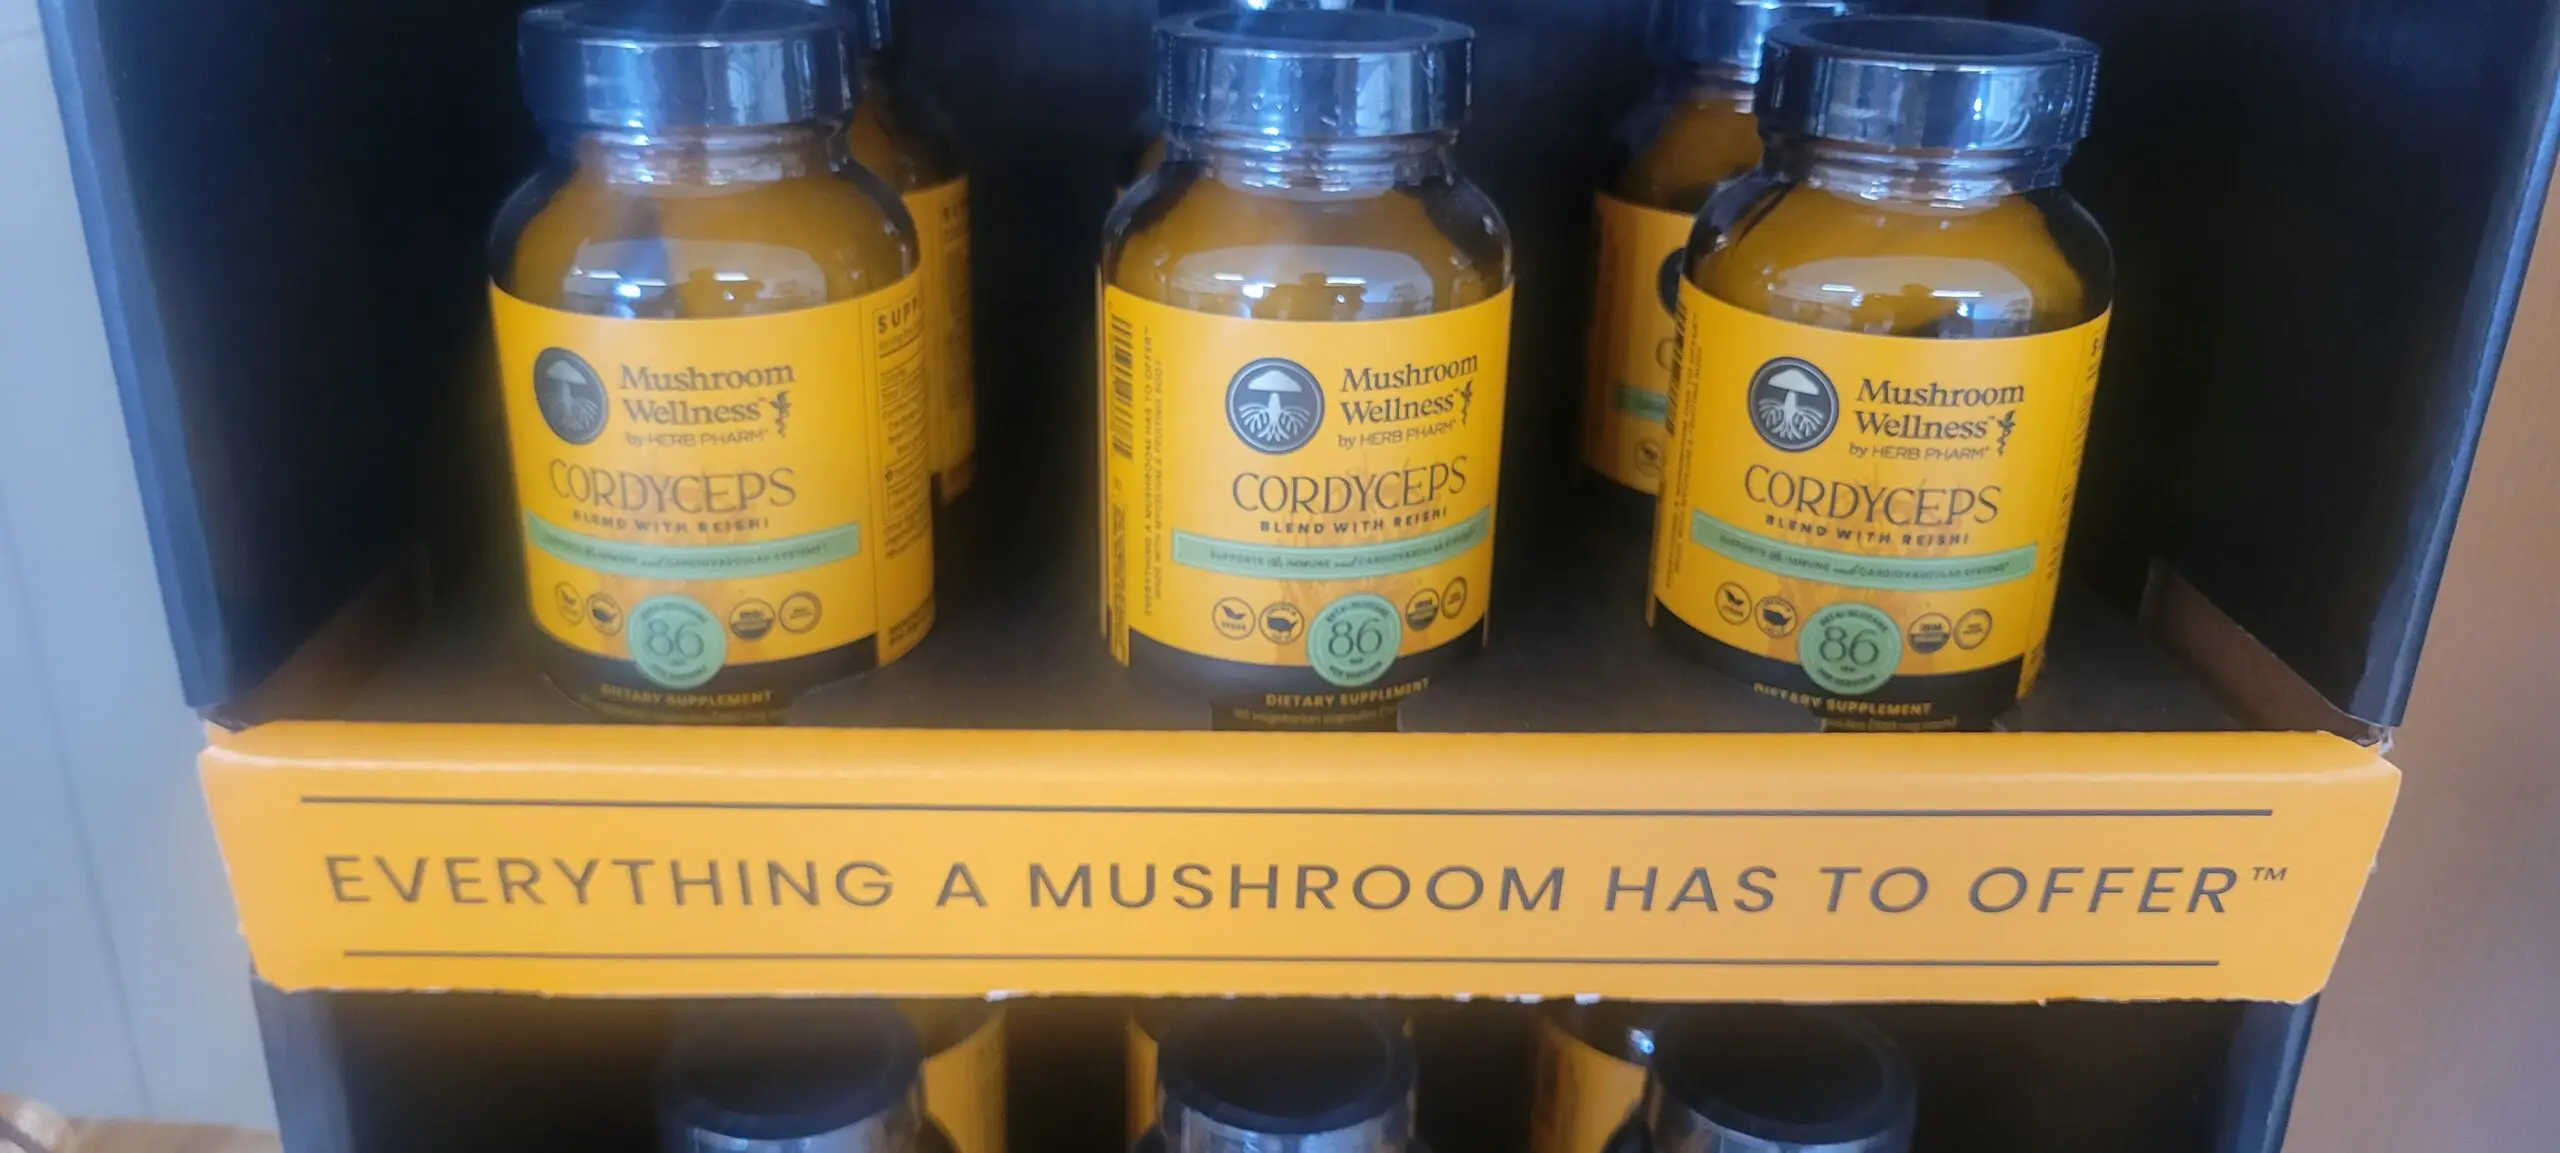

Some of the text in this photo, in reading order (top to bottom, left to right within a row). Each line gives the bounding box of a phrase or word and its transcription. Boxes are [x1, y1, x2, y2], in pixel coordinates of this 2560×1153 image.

[618, 364, 797, 391] Mushroom
[1340, 354, 1478, 392] Mushroom
[1856, 377, 2025, 407] Mushroom
[626, 432, 643, 447] by
[648, 432, 696, 447] HERB
[1338, 434, 1356, 449] by
[1360, 430, 1403, 446] HERB
[1849, 443, 1868, 458] by
[1872, 445, 1920, 461] HERB
[550, 458, 796, 514] CORDYCEPS
[1232, 456, 1467, 515] CORDYCEPS
[1744, 464, 2002, 527] CORDYCEPS
[573, 510, 770, 533] BLEND WITH REISHI
[1260, 507, 1447, 534] BLEND WITH REISHI
[1766, 514, 1969, 545] BLEND WITH REISHI
[647, 618, 705, 660] 86
[1328, 617, 1383, 658] 86
[1819, 625, 1880, 667] 86
[665, 690, 774, 706] SUPPLEMENT
[1265, 677, 1430, 708] DIETARY SUPPLEMENT
[1825, 698, 1933, 716] SUPPLEMENT
[325, 856, 893, 907] EVERYTHING
[934, 862, 988, 908] A
[1029, 863, 1565, 912] MUSHROOM
[1604, 866, 1777, 913] HAS
[1819, 866, 1929, 914] TO
